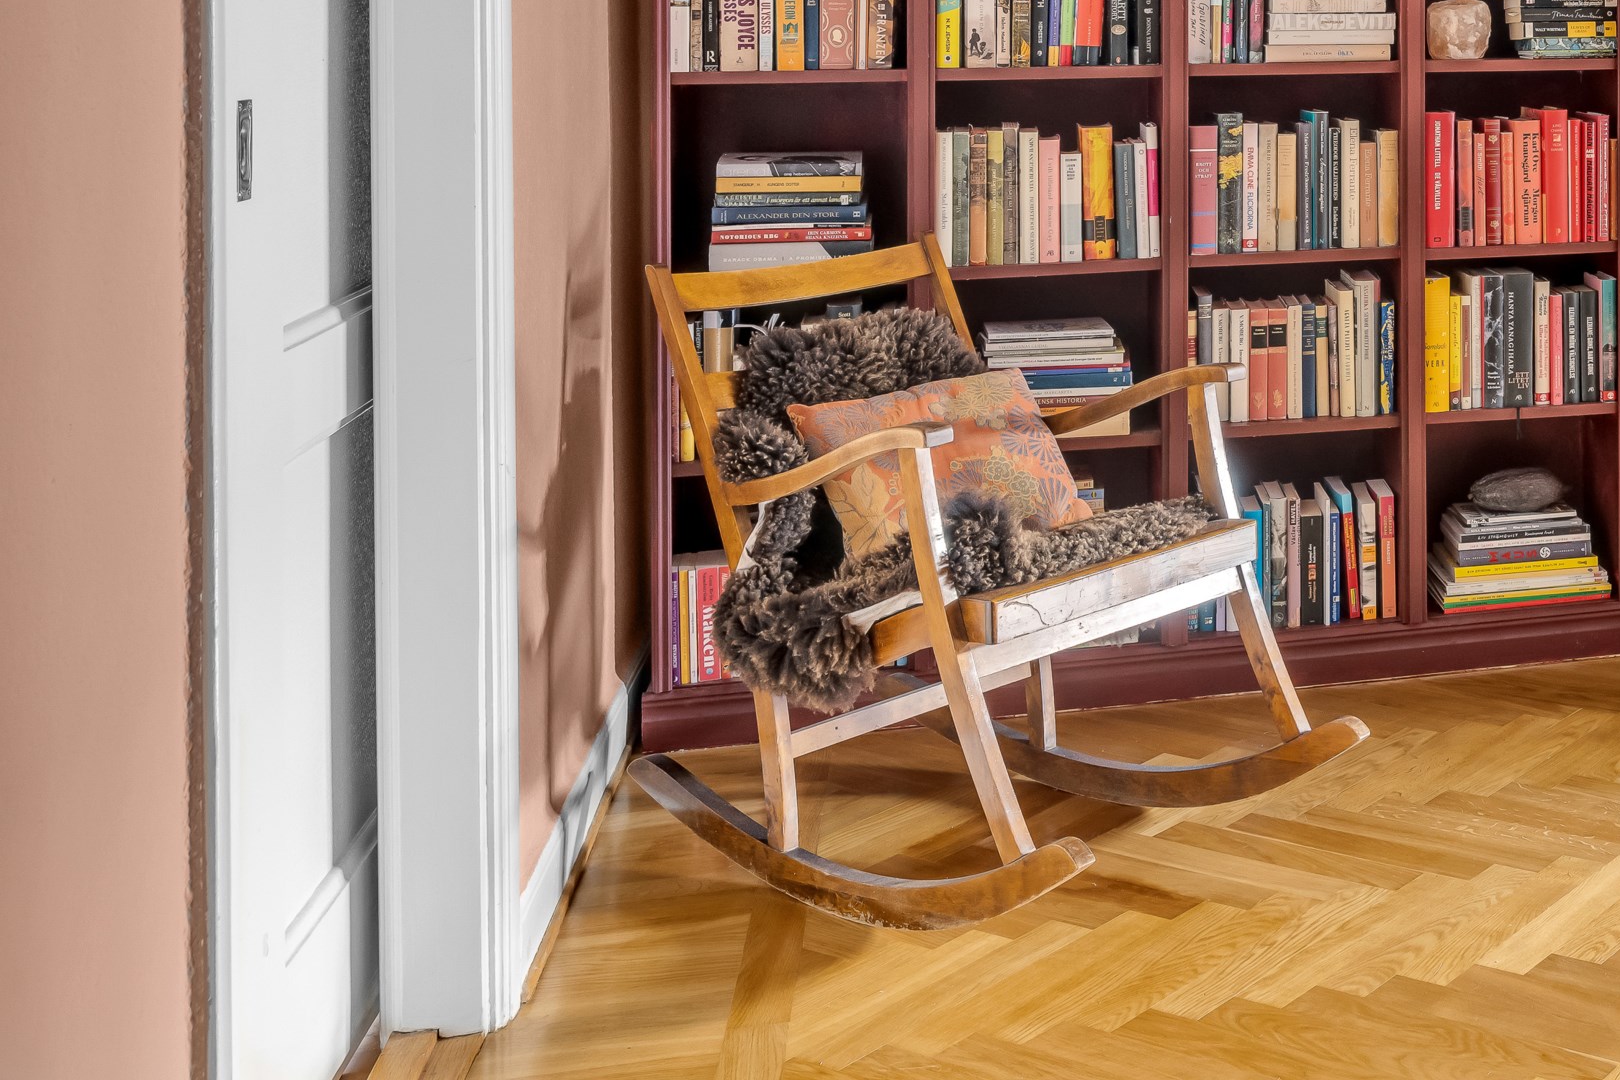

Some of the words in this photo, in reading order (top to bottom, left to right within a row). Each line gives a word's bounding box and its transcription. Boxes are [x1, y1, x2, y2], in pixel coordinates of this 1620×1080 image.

[737, 10, 755, 50] JOYCE
[761, 2, 771, 35] ULYSSES
[1349, 128, 1357, 154] Elena
[1522, 133, 1531, 182] Knausgård
[1349, 158, 1357, 200] Ferrante
[1522, 188, 1531, 226] stjärnan
[1531, 188, 1540, 223] Morgon
[1489, 549, 1537, 562] MAUS
